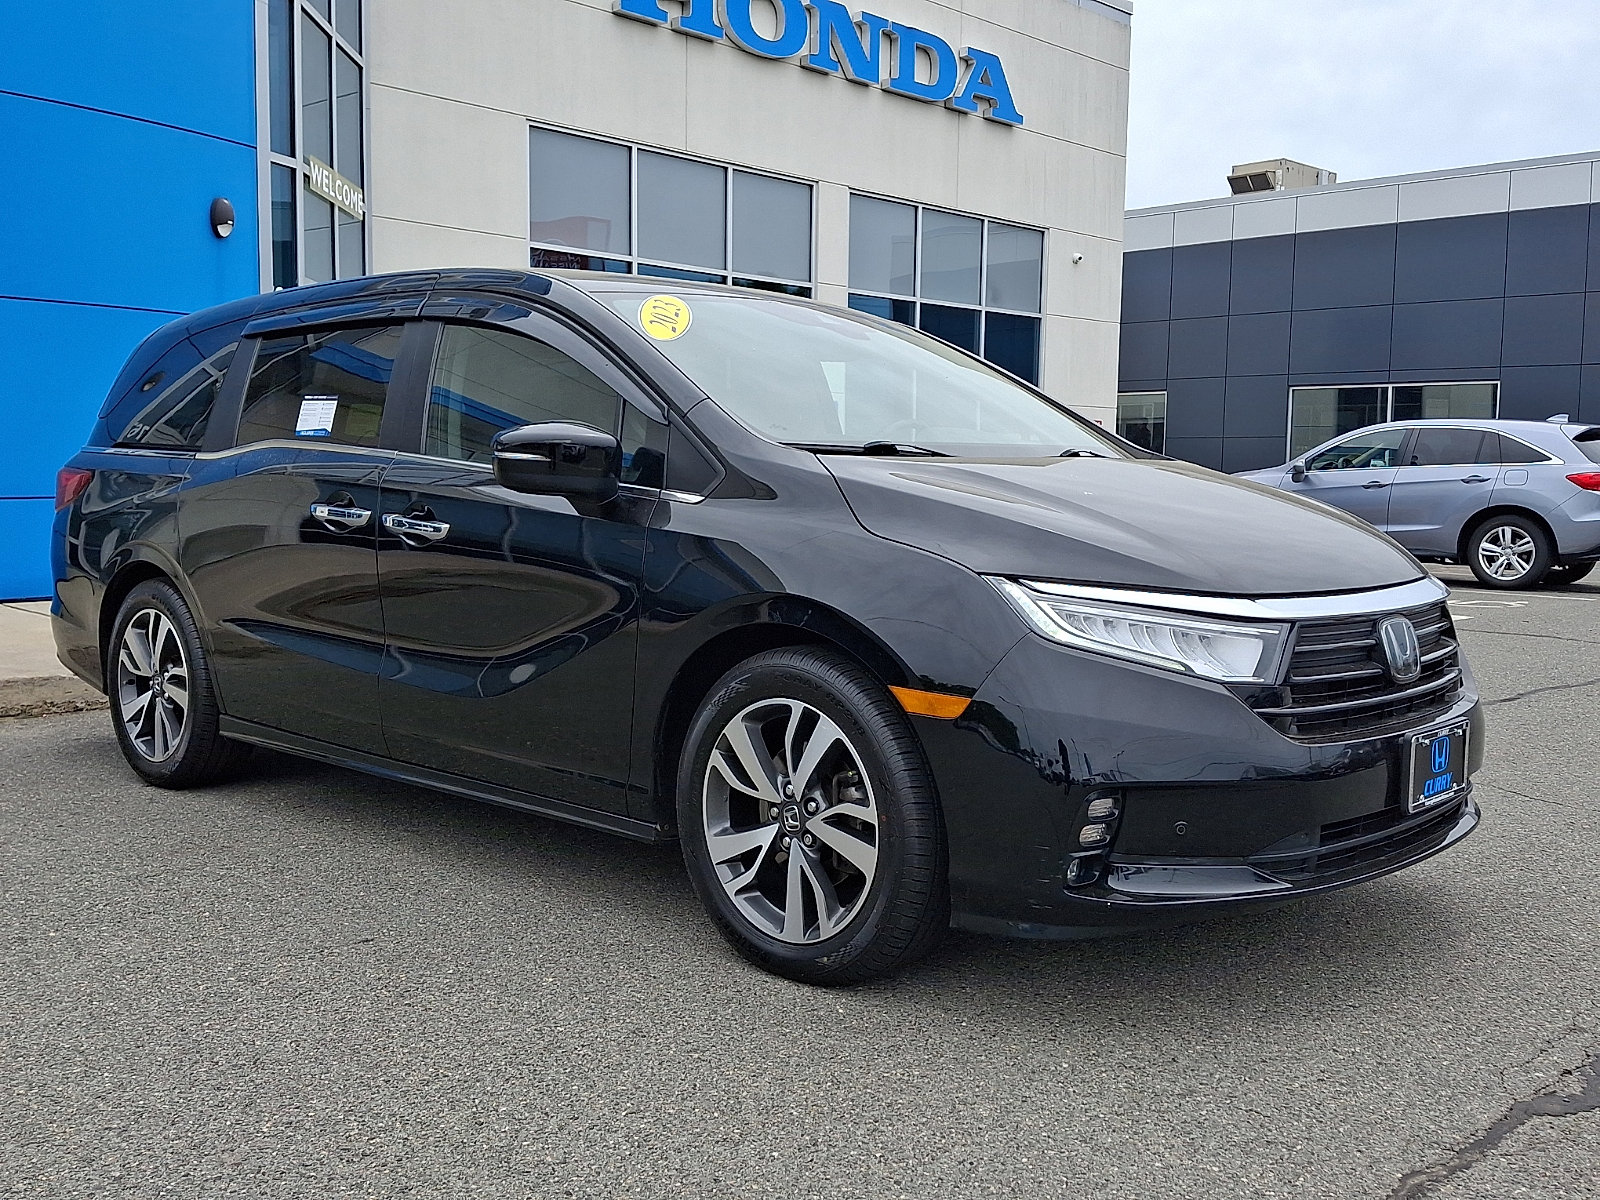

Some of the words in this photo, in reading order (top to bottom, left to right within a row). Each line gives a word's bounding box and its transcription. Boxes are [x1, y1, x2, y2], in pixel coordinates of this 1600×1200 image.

[309, 160, 363, 215] WELCOME
[649, 299, 681, 333] 2023
[1424, 772, 1453, 796] CURRY
